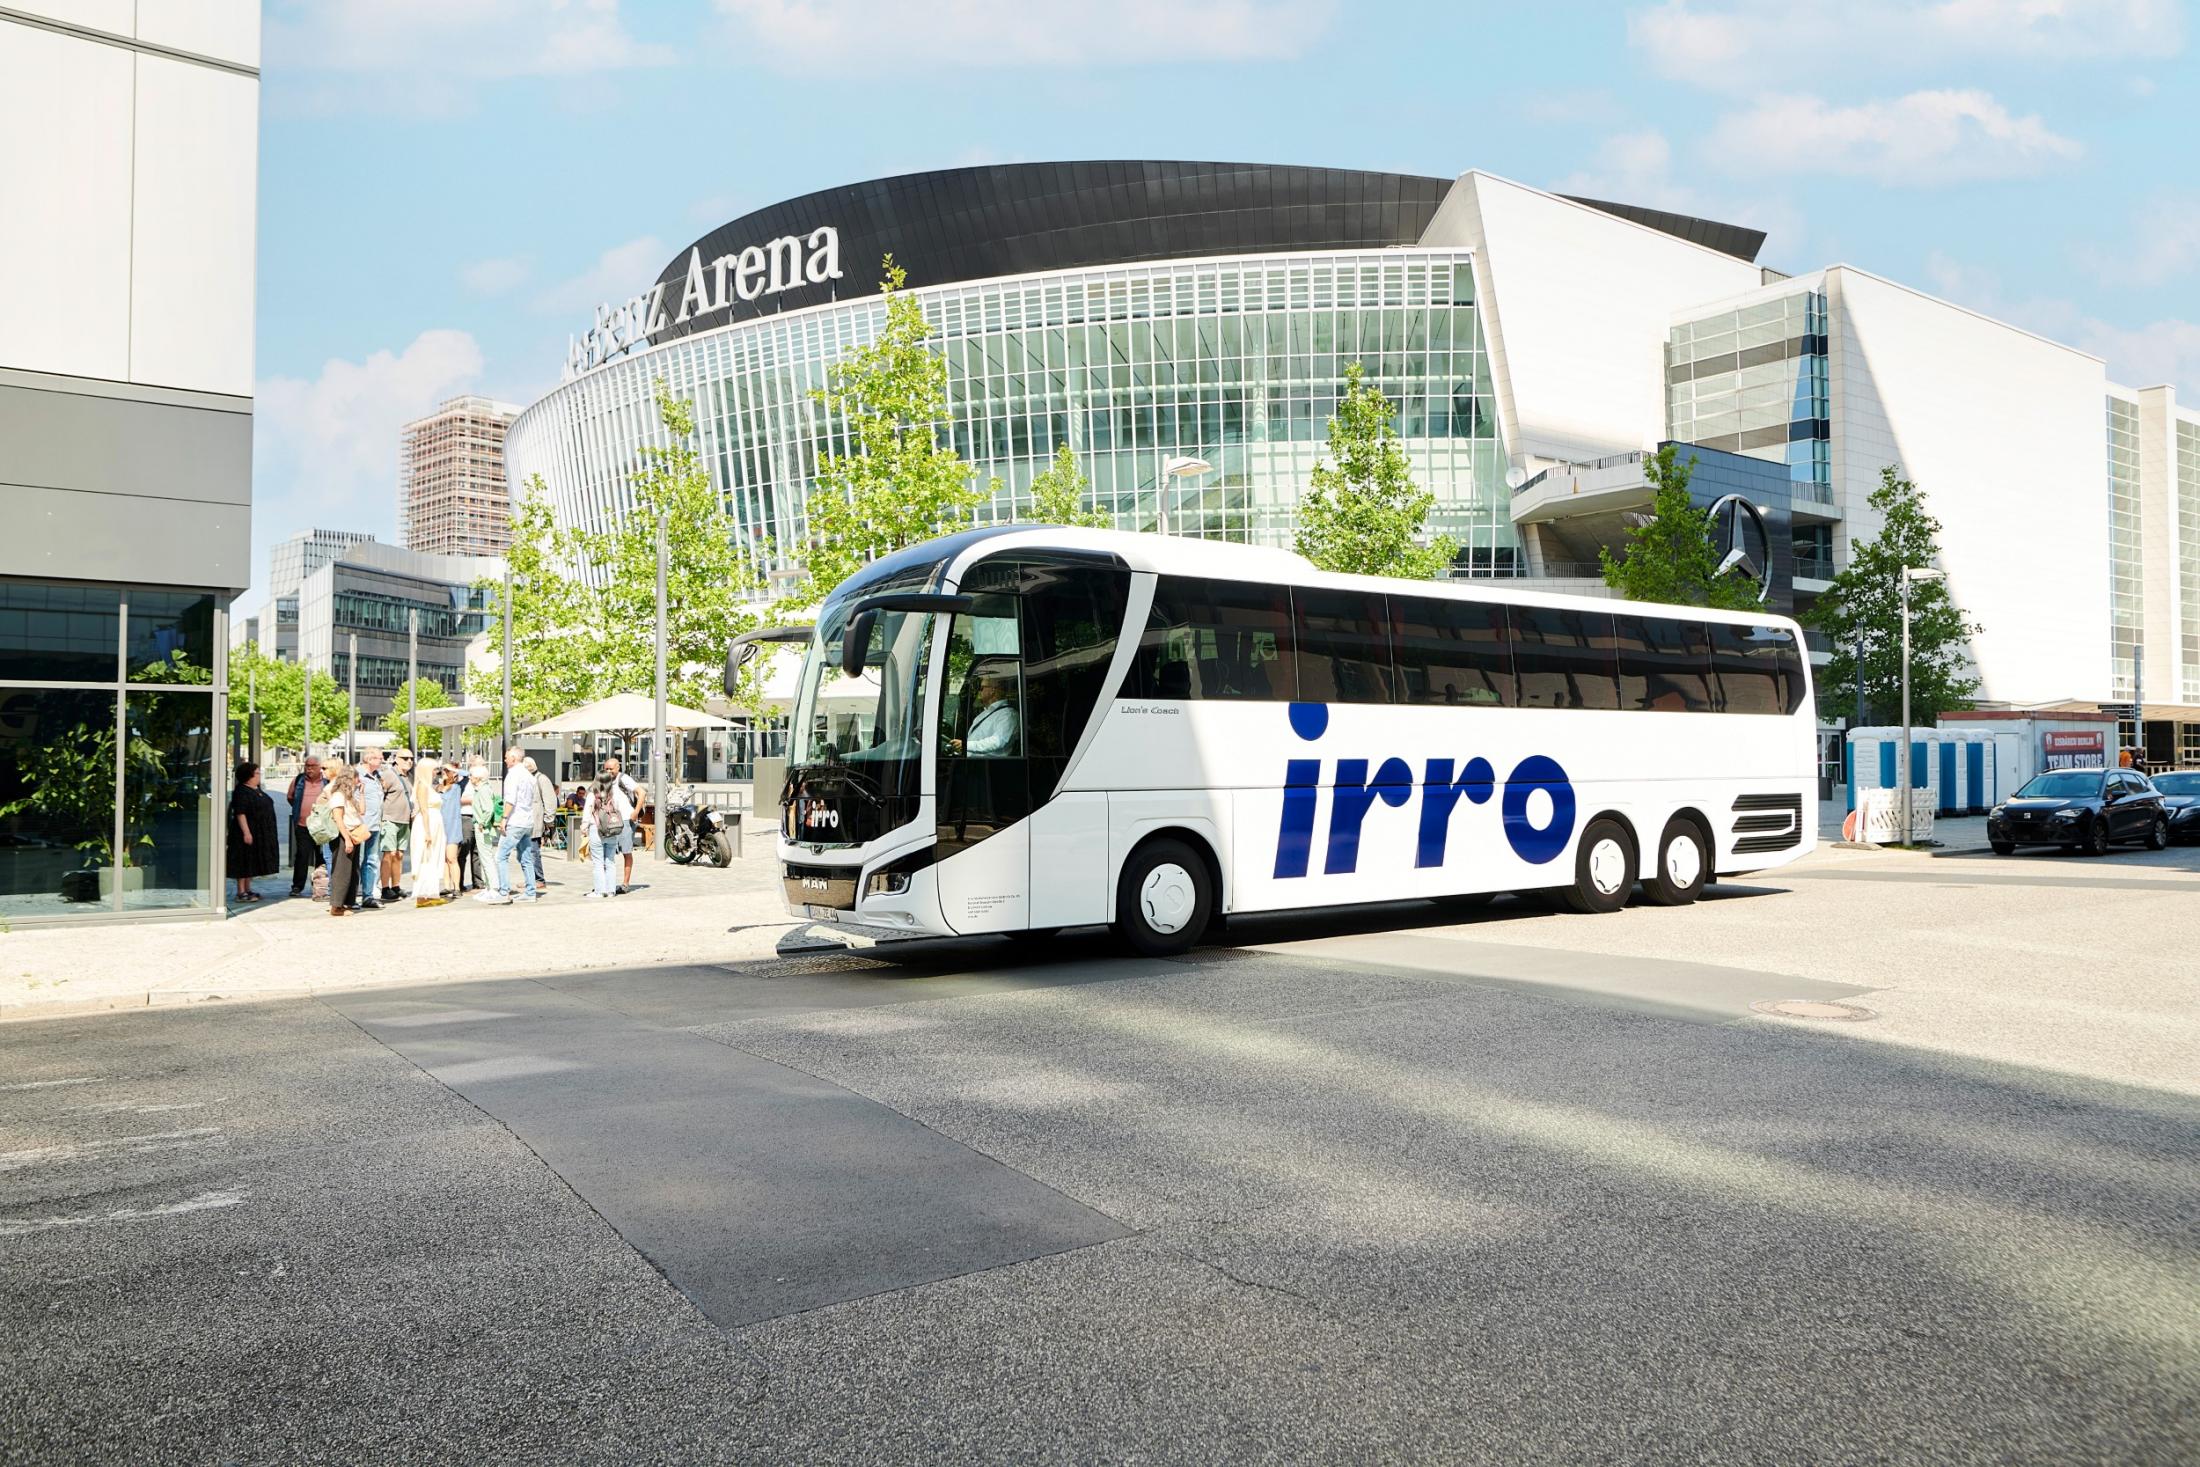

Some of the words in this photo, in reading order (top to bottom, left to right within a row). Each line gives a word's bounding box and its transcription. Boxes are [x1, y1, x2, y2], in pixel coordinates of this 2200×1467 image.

[675, 226, 843, 323] Arena
[1121, 706, 1148, 714] Lion's
[1150, 706, 1180, 715] Coach
[2047, 754, 2073, 769] TEAM
[2074, 753, 2103, 769] STORE
[1272, 702, 1576, 879] irro
[811, 800, 839, 828] irro
[802, 878, 828, 890] MAN
